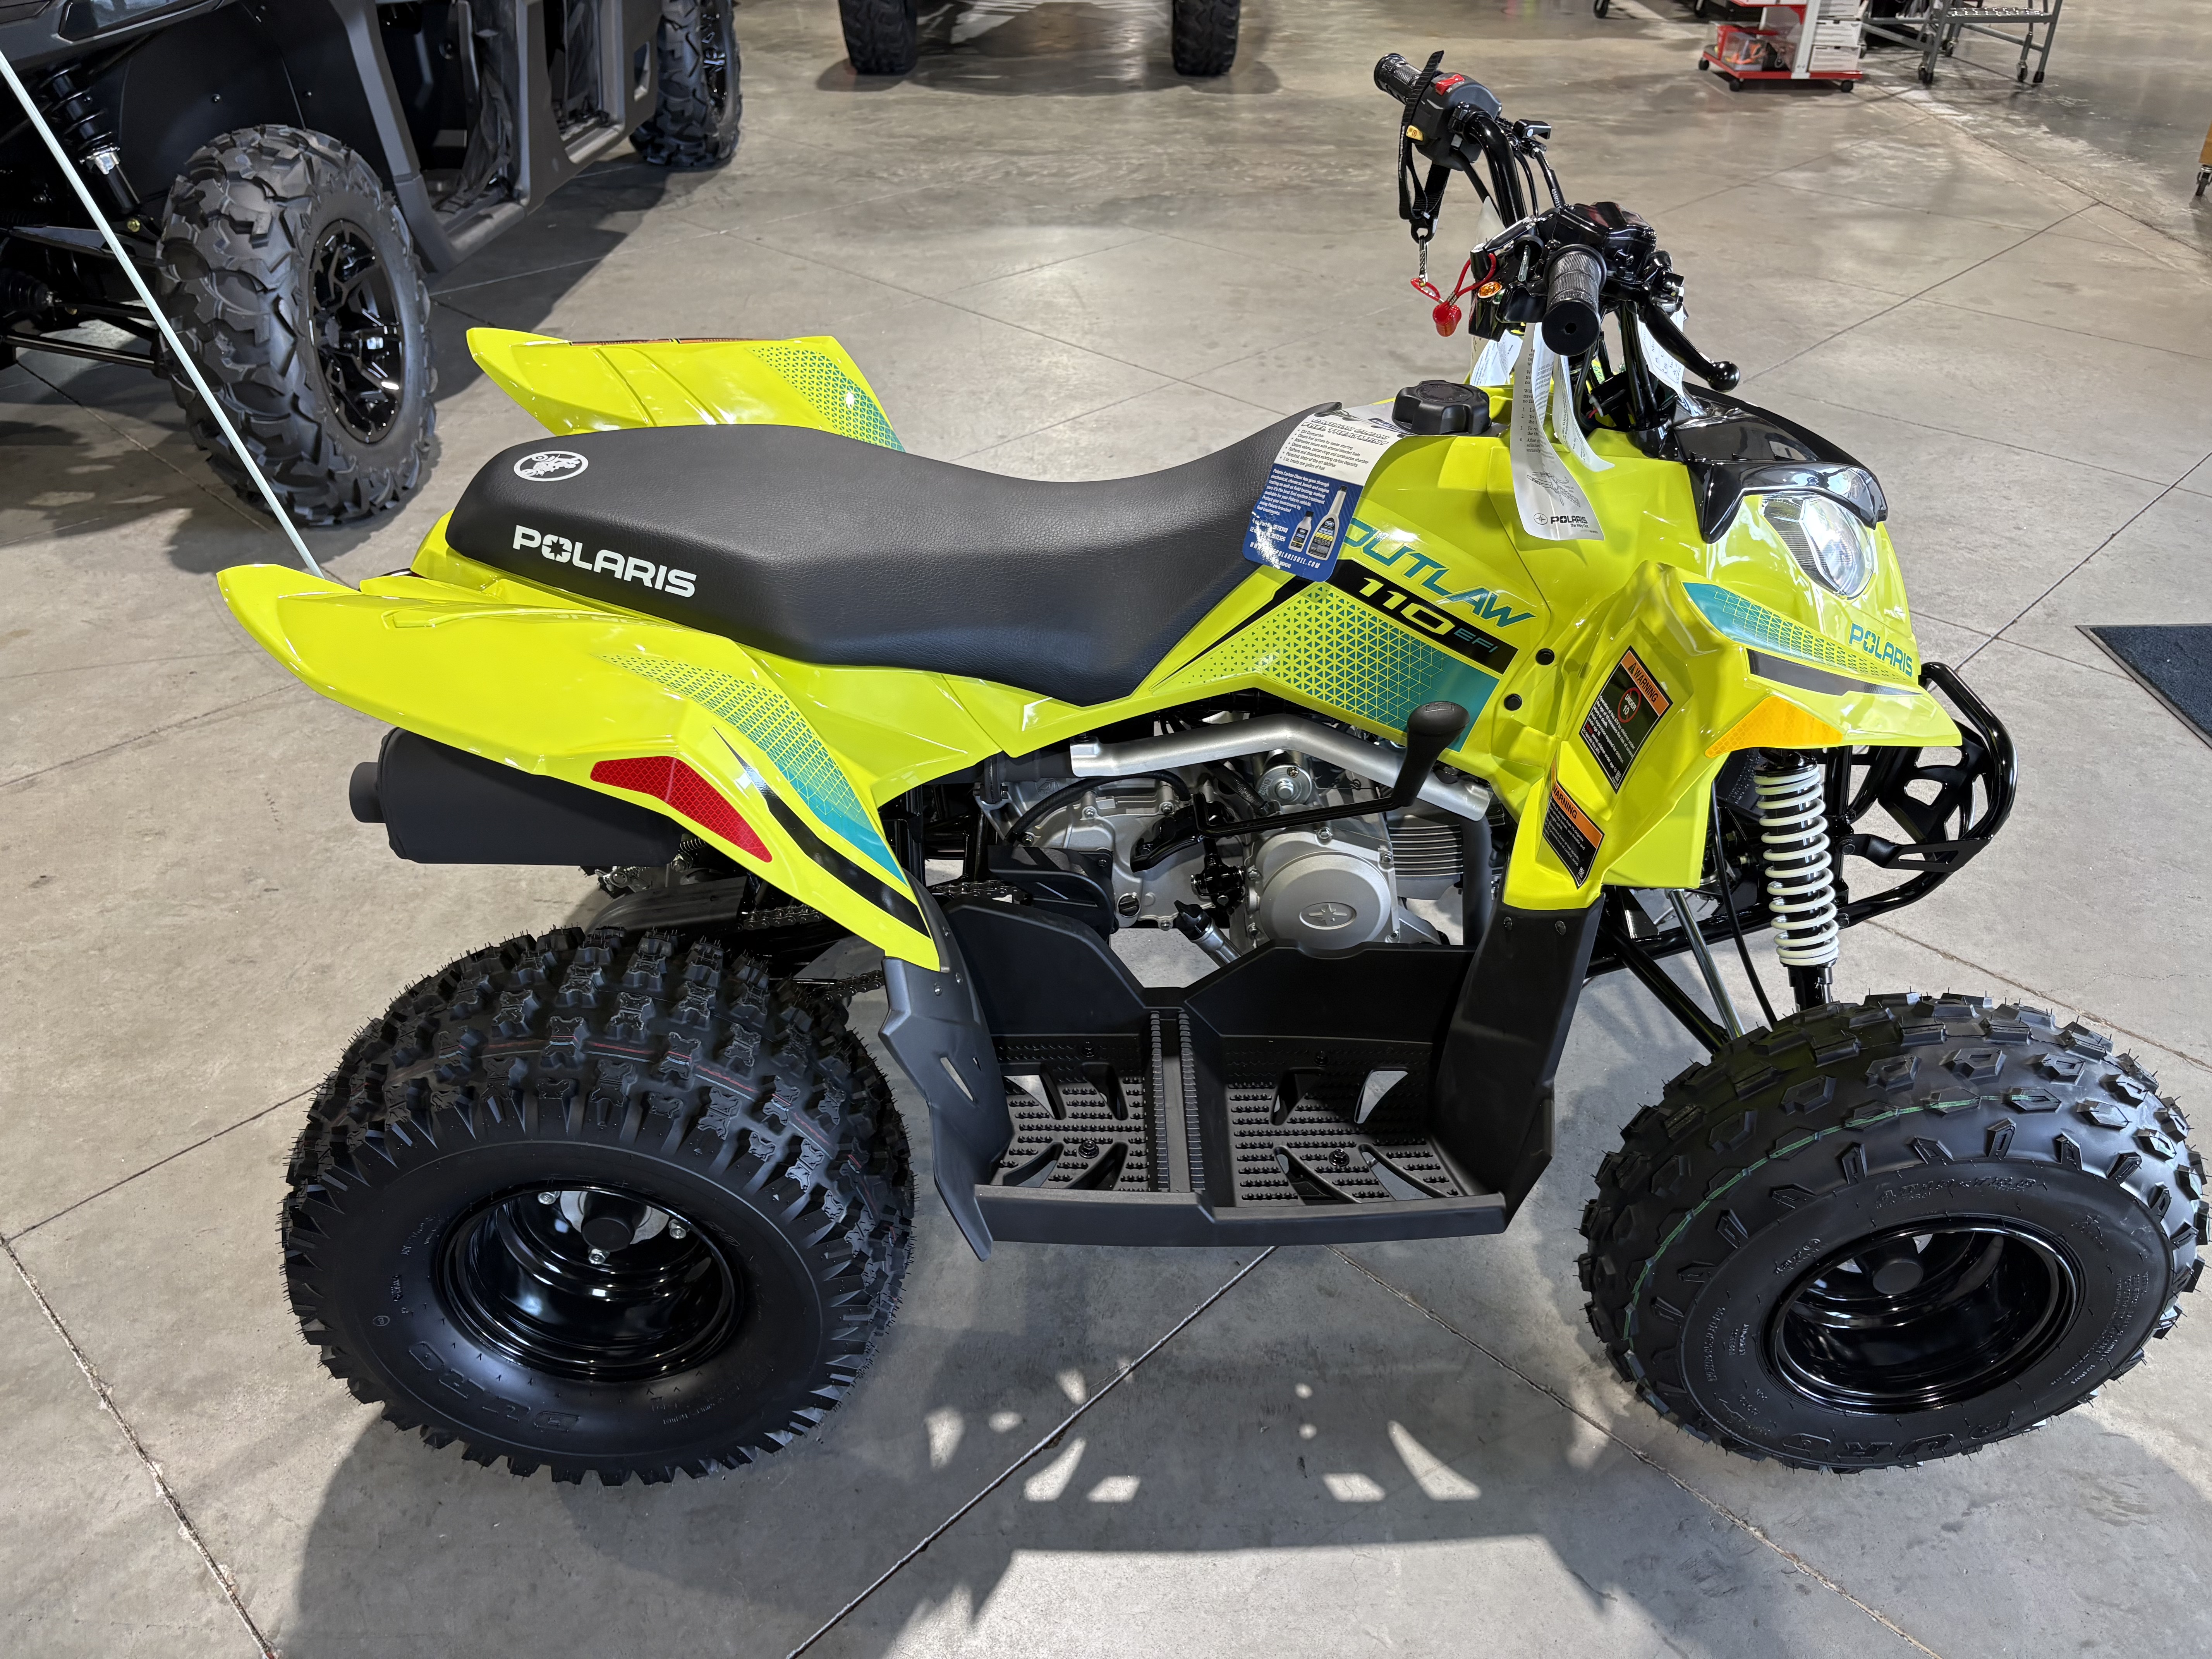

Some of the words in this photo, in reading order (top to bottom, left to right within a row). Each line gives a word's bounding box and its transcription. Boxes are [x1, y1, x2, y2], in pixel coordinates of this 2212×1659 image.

[1301, 422, 1326, 431] FUEL
[1328, 428, 1388, 445] TREATMENT
[1311, 419, 1355, 431] CARBON
[1354, 429, 1389, 439] CLEAN
[1551, 516, 1588, 524] POLARIS
[513, 525, 697, 597] POLARIS
[1343, 518, 1537, 628] OUTLAW
[1359, 577, 1455, 635] 110
[1454, 628, 1498, 653] EFI
[1849, 623, 1913, 677] POLARIS
[1625, 694, 1637, 711] UNDER
[1634, 668, 1658, 704] WARNING
[1599, 696, 1609, 711] Operation
[1621, 729, 1629, 741] children
[1623, 705, 1630, 715] 10
[408, 1341, 580, 1432] DURO
